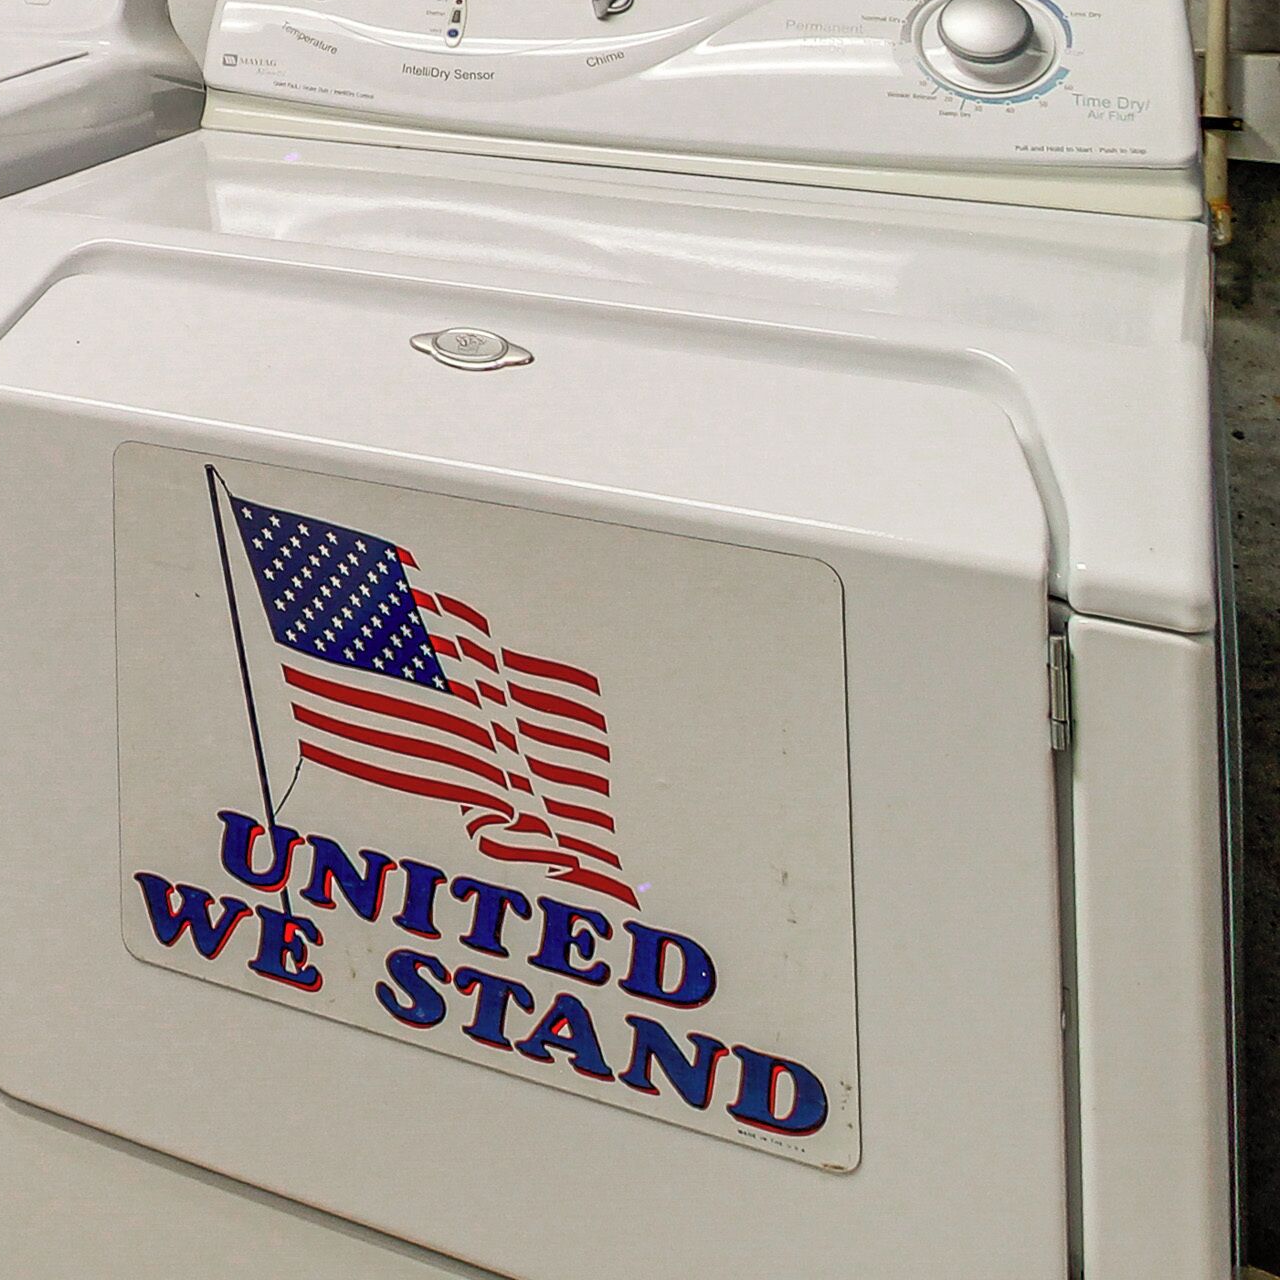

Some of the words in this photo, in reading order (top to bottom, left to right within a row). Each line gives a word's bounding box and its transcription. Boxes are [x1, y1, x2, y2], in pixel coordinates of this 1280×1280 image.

[282, 21, 338, 55] Temperature
[586, 51, 625, 68] Chime
[401, 63, 451, 81] IntelliDry
[454, 69, 496, 81] Sensor
[1072, 92, 1112, 109] Time
[1087, 109, 1105, 120] Air
[217, 810, 715, 1010] UNITED
[134, 871, 322, 992] WE
[376, 948, 829, 1138] STAND
